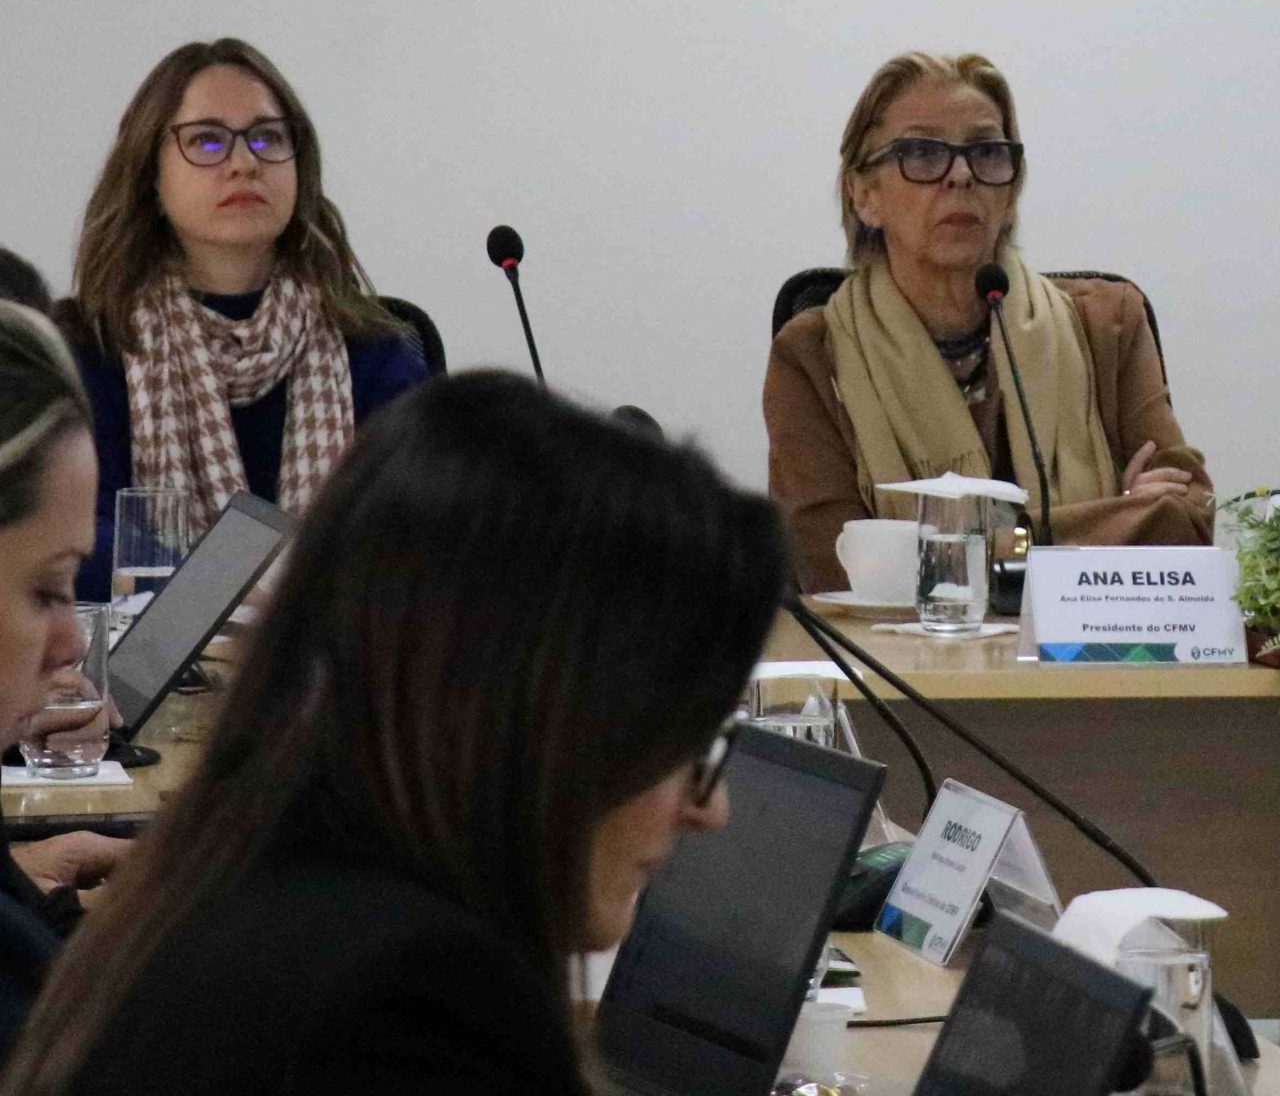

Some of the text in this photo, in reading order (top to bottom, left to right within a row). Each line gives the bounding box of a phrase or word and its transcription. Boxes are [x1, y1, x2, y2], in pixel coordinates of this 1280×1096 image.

[1077, 571, 1196, 586] ANA ELISA
[1082, 623, 1196, 632] Presidente do CFMV
[940, 819, 982, 852] RODRIGO
